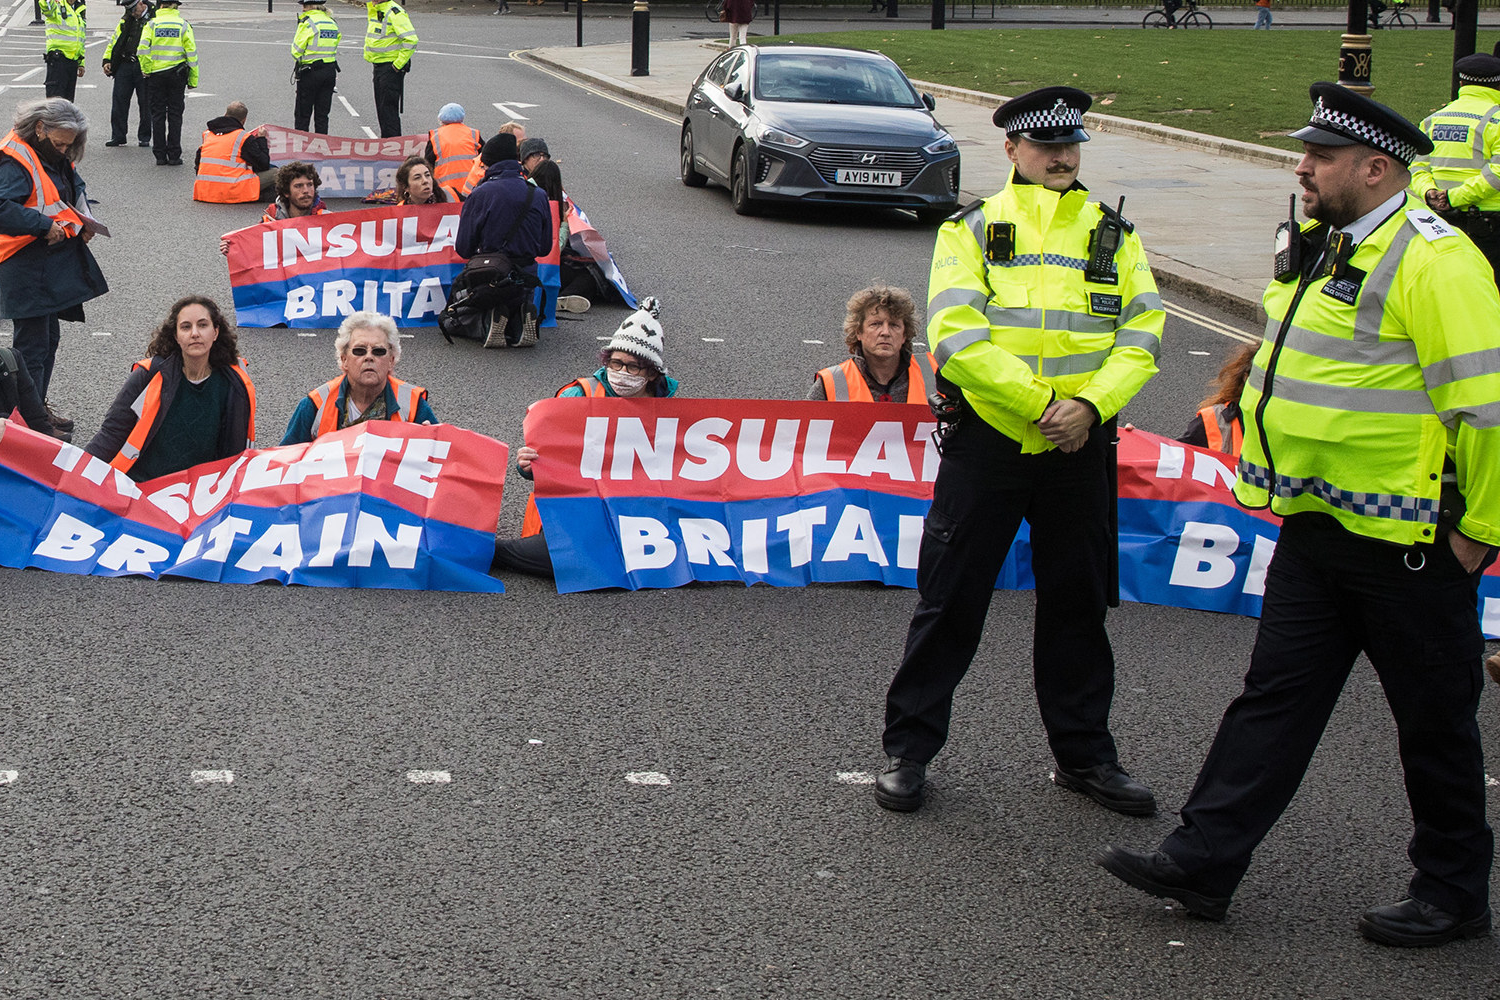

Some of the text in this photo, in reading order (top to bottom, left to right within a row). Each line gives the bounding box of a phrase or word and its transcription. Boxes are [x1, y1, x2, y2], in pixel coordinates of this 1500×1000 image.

[1433, 130, 1467, 142] POLICE
[844, 171, 895, 184] AY19 MTV
[261, 213, 461, 270] INSULA
[283, 276, 448, 322] BRITA
[1335, 291, 1354, 302] OFFICER
[579, 416, 939, 482] INSULAT
[618, 504, 925, 574] BRITAI
